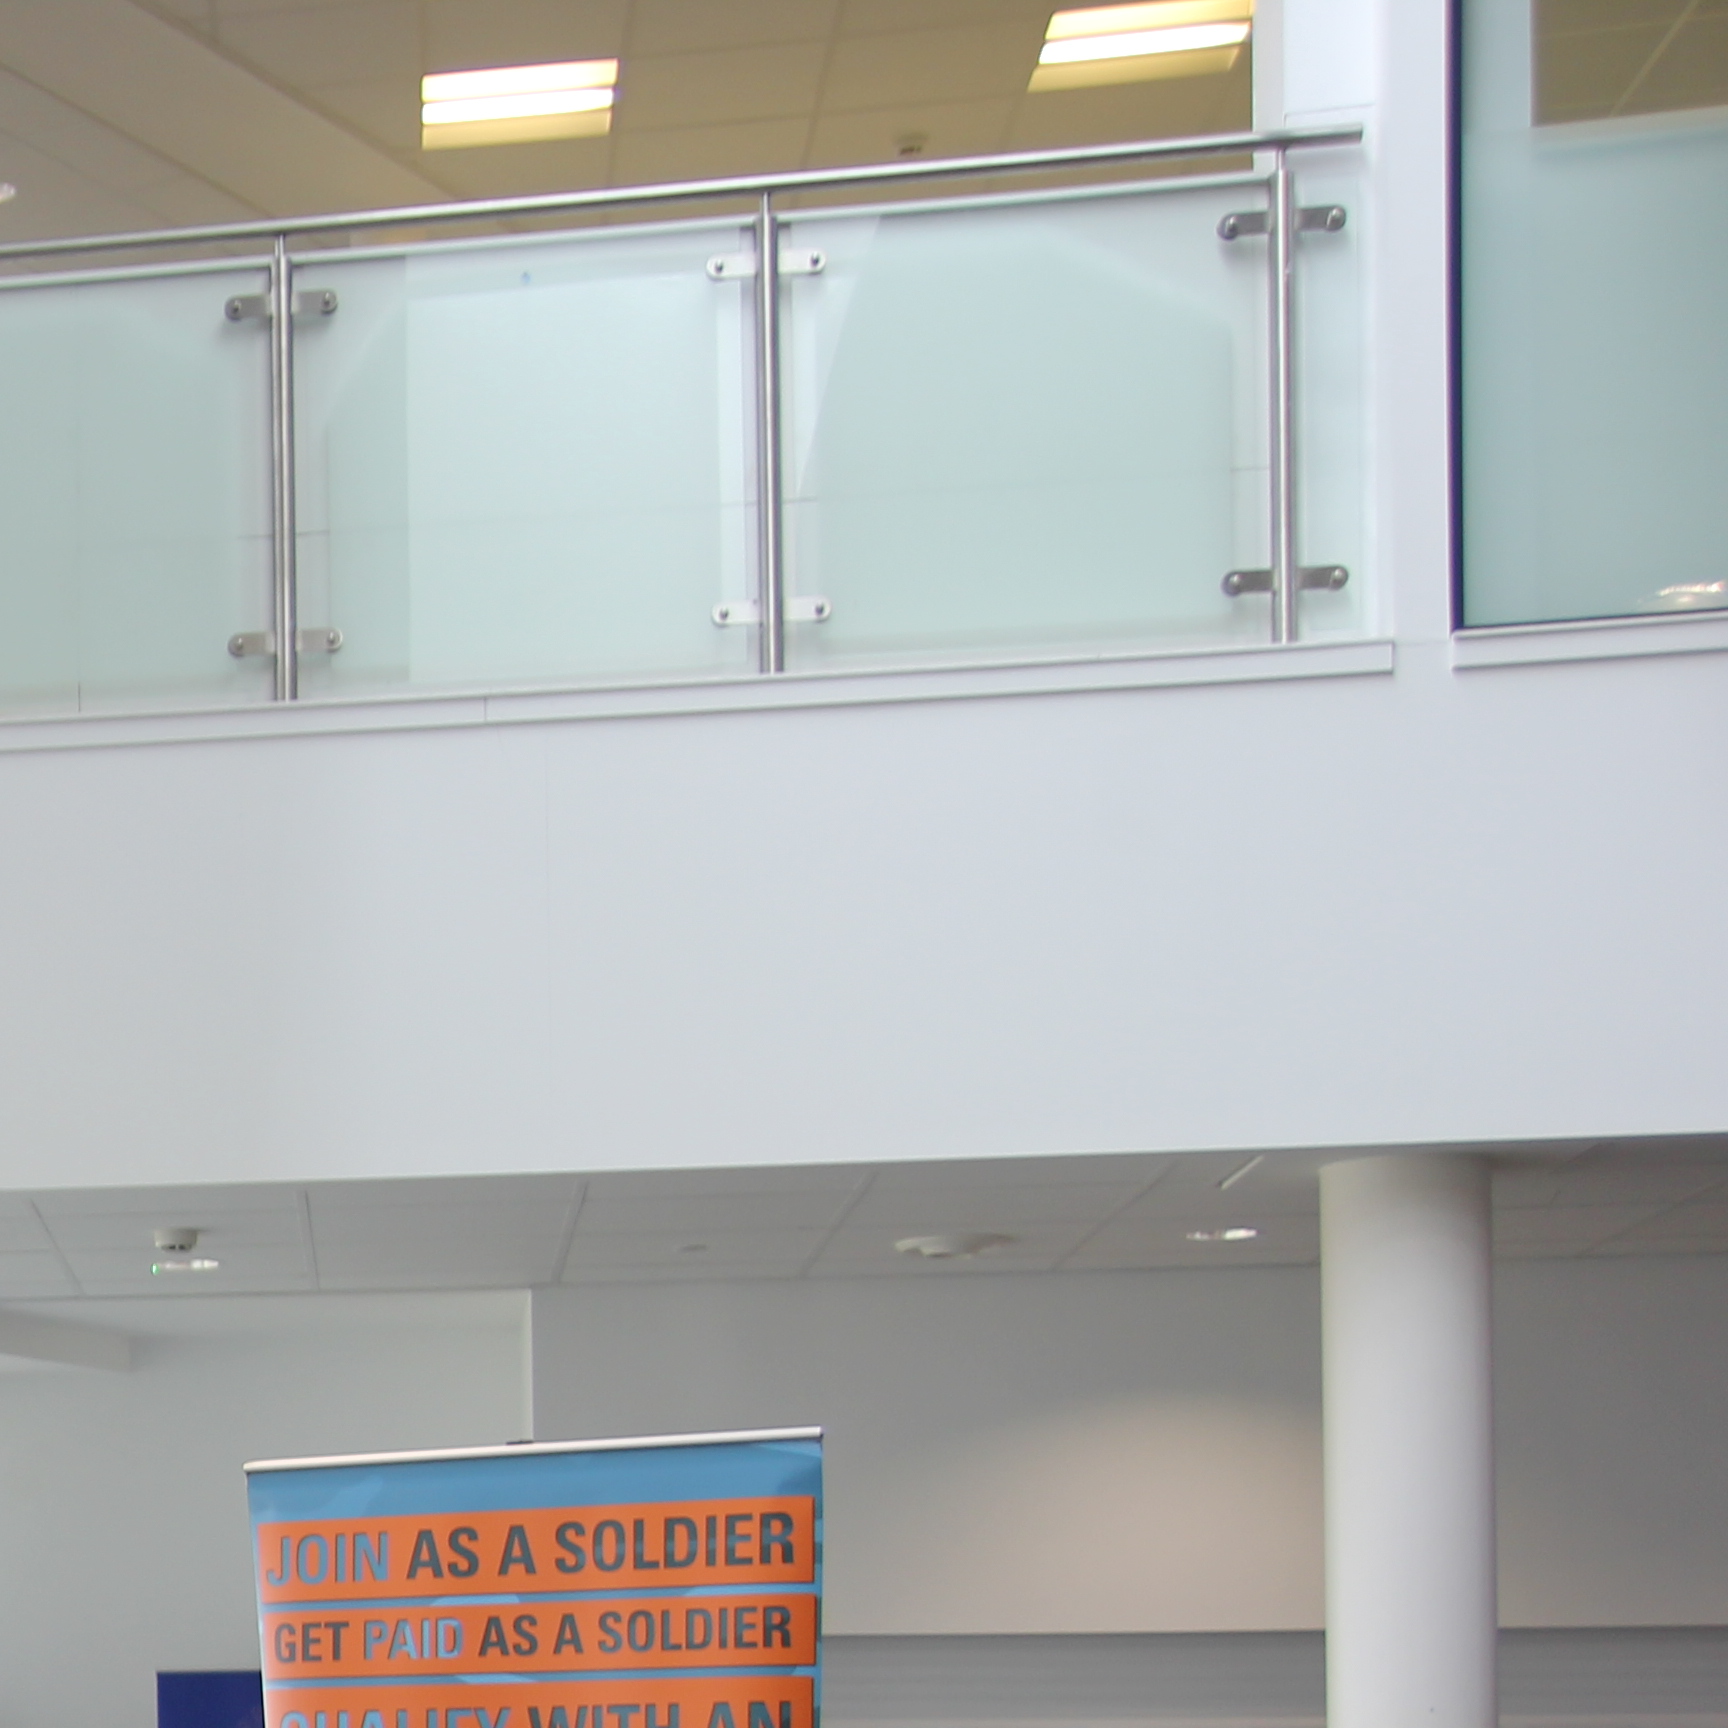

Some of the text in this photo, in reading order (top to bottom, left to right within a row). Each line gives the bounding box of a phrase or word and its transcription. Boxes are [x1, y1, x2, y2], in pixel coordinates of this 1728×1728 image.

[266, 1511, 795, 1586] JOIN AS A SOLDIER
[274, 1604, 791, 1663] GET PAID AS A SOLDIER
